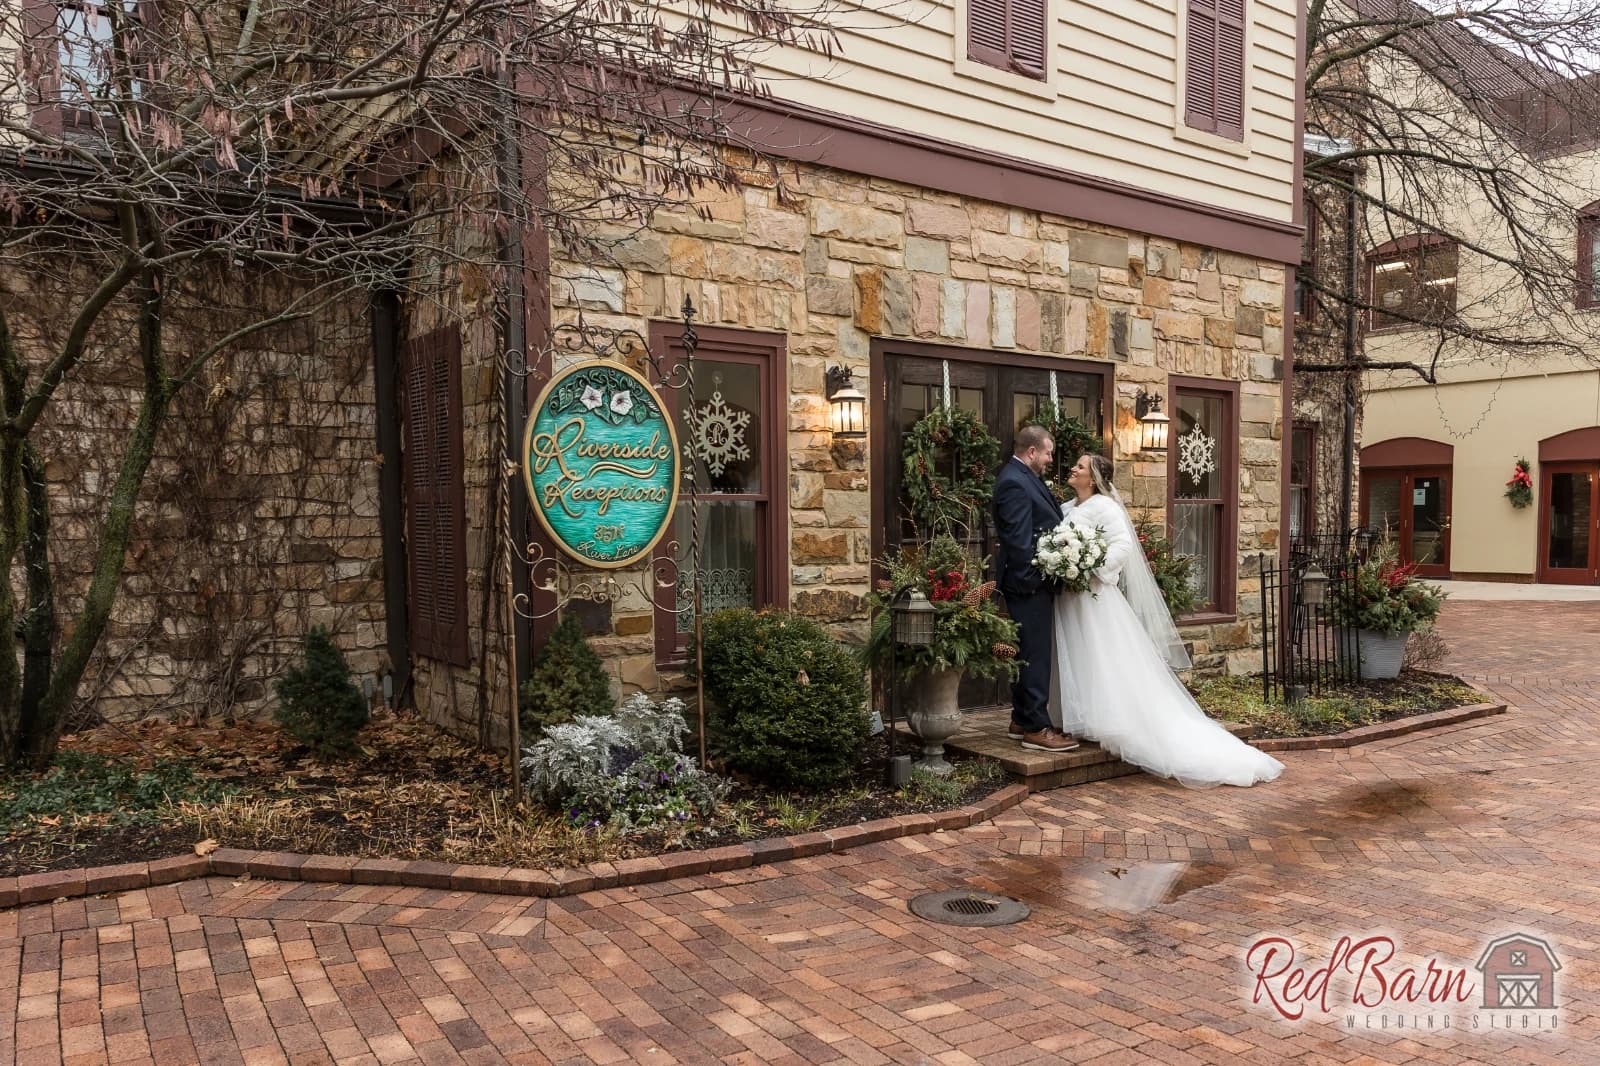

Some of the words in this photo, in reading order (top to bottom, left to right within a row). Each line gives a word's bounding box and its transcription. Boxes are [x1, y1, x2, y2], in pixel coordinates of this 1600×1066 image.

[532, 417, 671, 482] Riverside
[543, 471, 668, 518] Receptions
[577, 540, 612, 560] River
[613, 544, 640, 560] Lane
